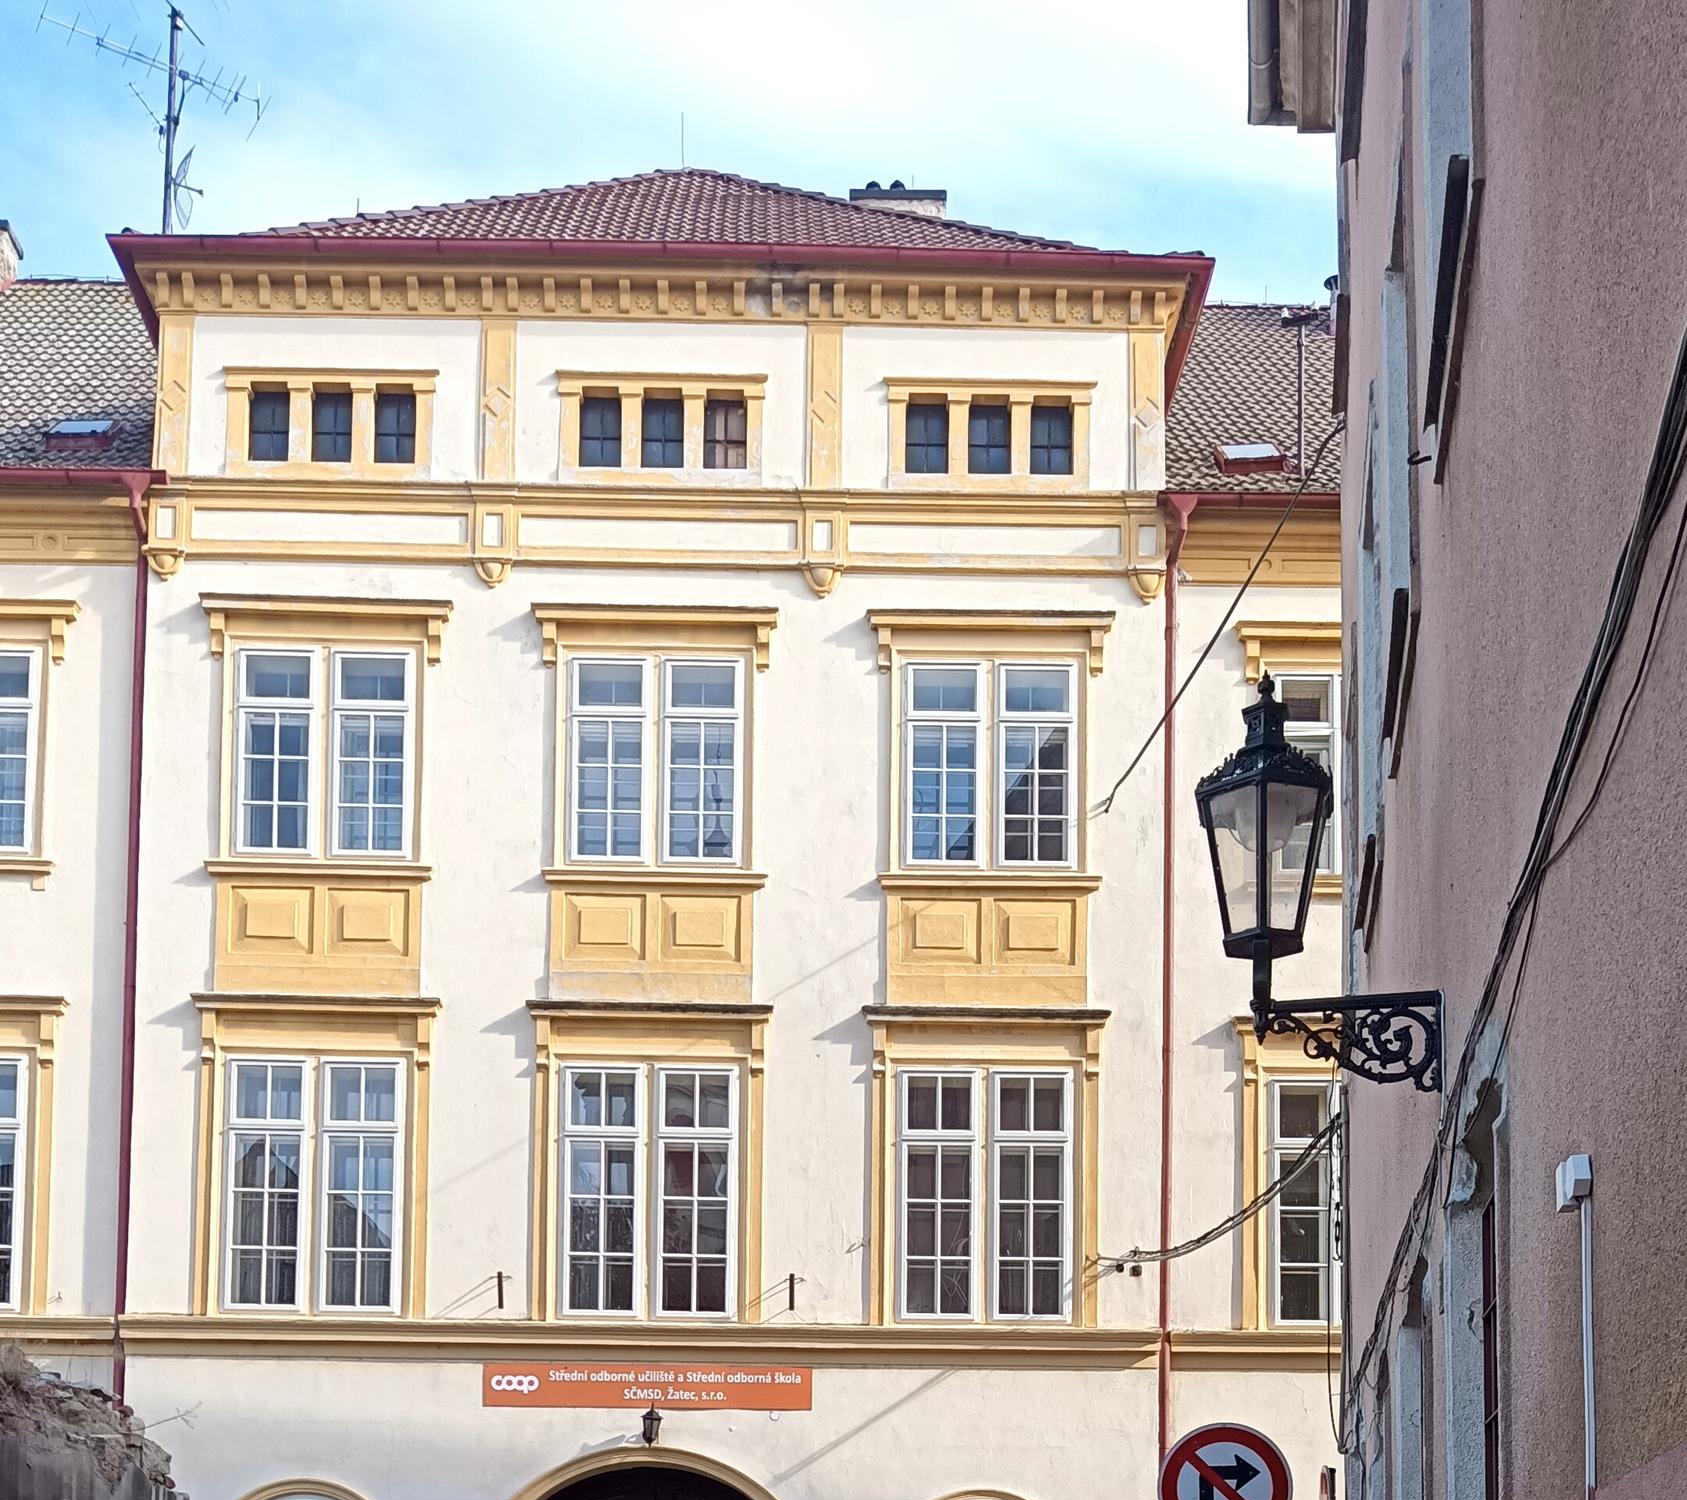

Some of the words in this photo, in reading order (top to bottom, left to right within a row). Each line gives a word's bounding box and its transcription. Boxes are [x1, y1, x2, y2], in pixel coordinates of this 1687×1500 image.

[549, 1369, 588, 1382] Střední
[591, 1370, 635, 1383] odborné
[638, 1371, 675, 1383] učiliště
[677, 1374, 684, 1383] a
[686, 1371, 725, 1384] Střední
[727, 1372, 771, 1384] odborná
[774, 1372, 801, 1384] škola
[624, 1386, 665, 1400] SČMSD,
[667, 1387, 699, 1401] Žatec,
[701, 1391, 727, 1400] s.r.o.
